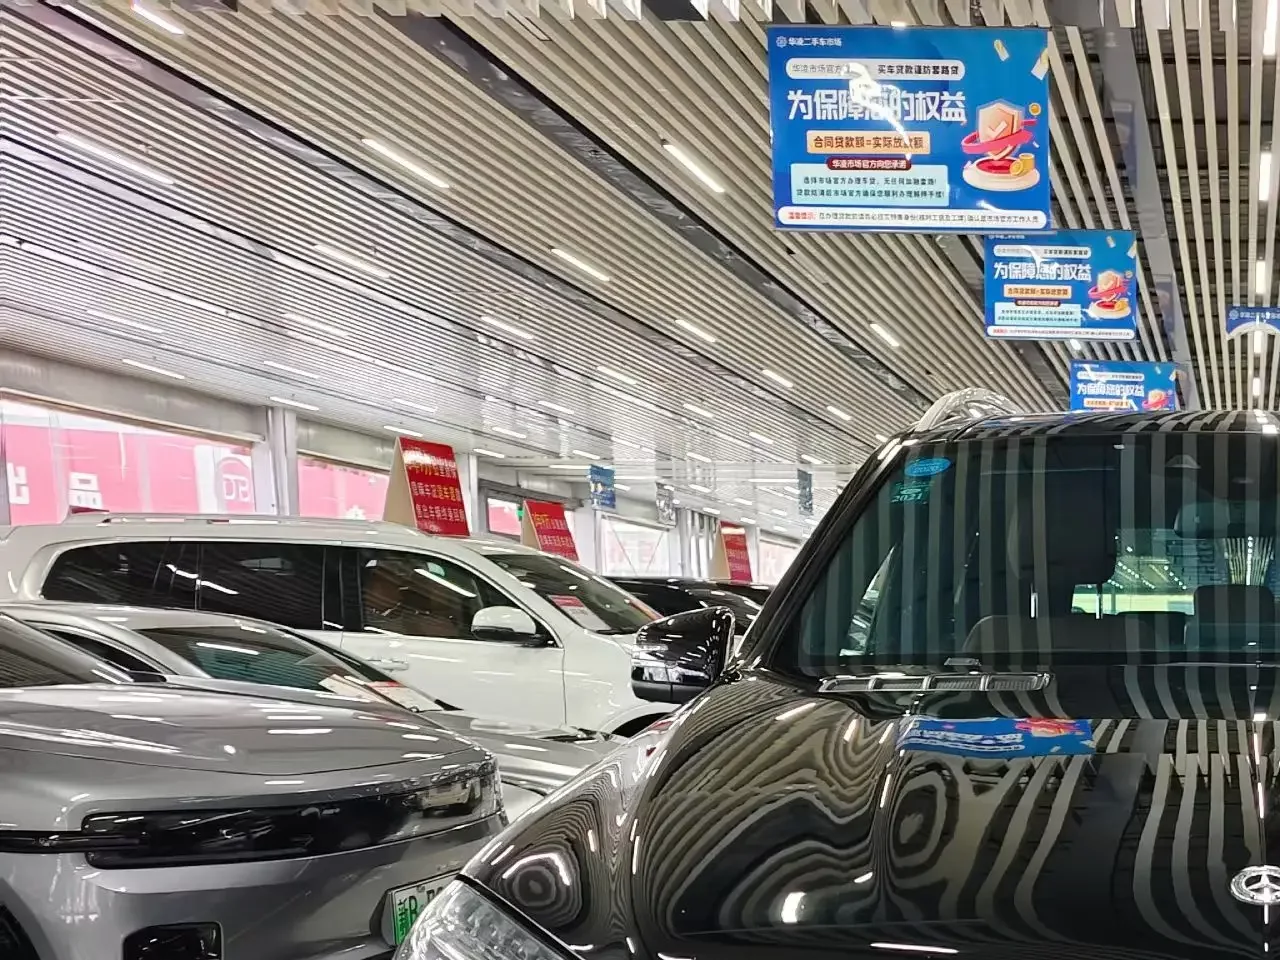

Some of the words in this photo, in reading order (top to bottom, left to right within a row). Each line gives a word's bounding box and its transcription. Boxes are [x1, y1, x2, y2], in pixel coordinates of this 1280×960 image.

[788, 37, 842, 48] 华凌二手车市场
